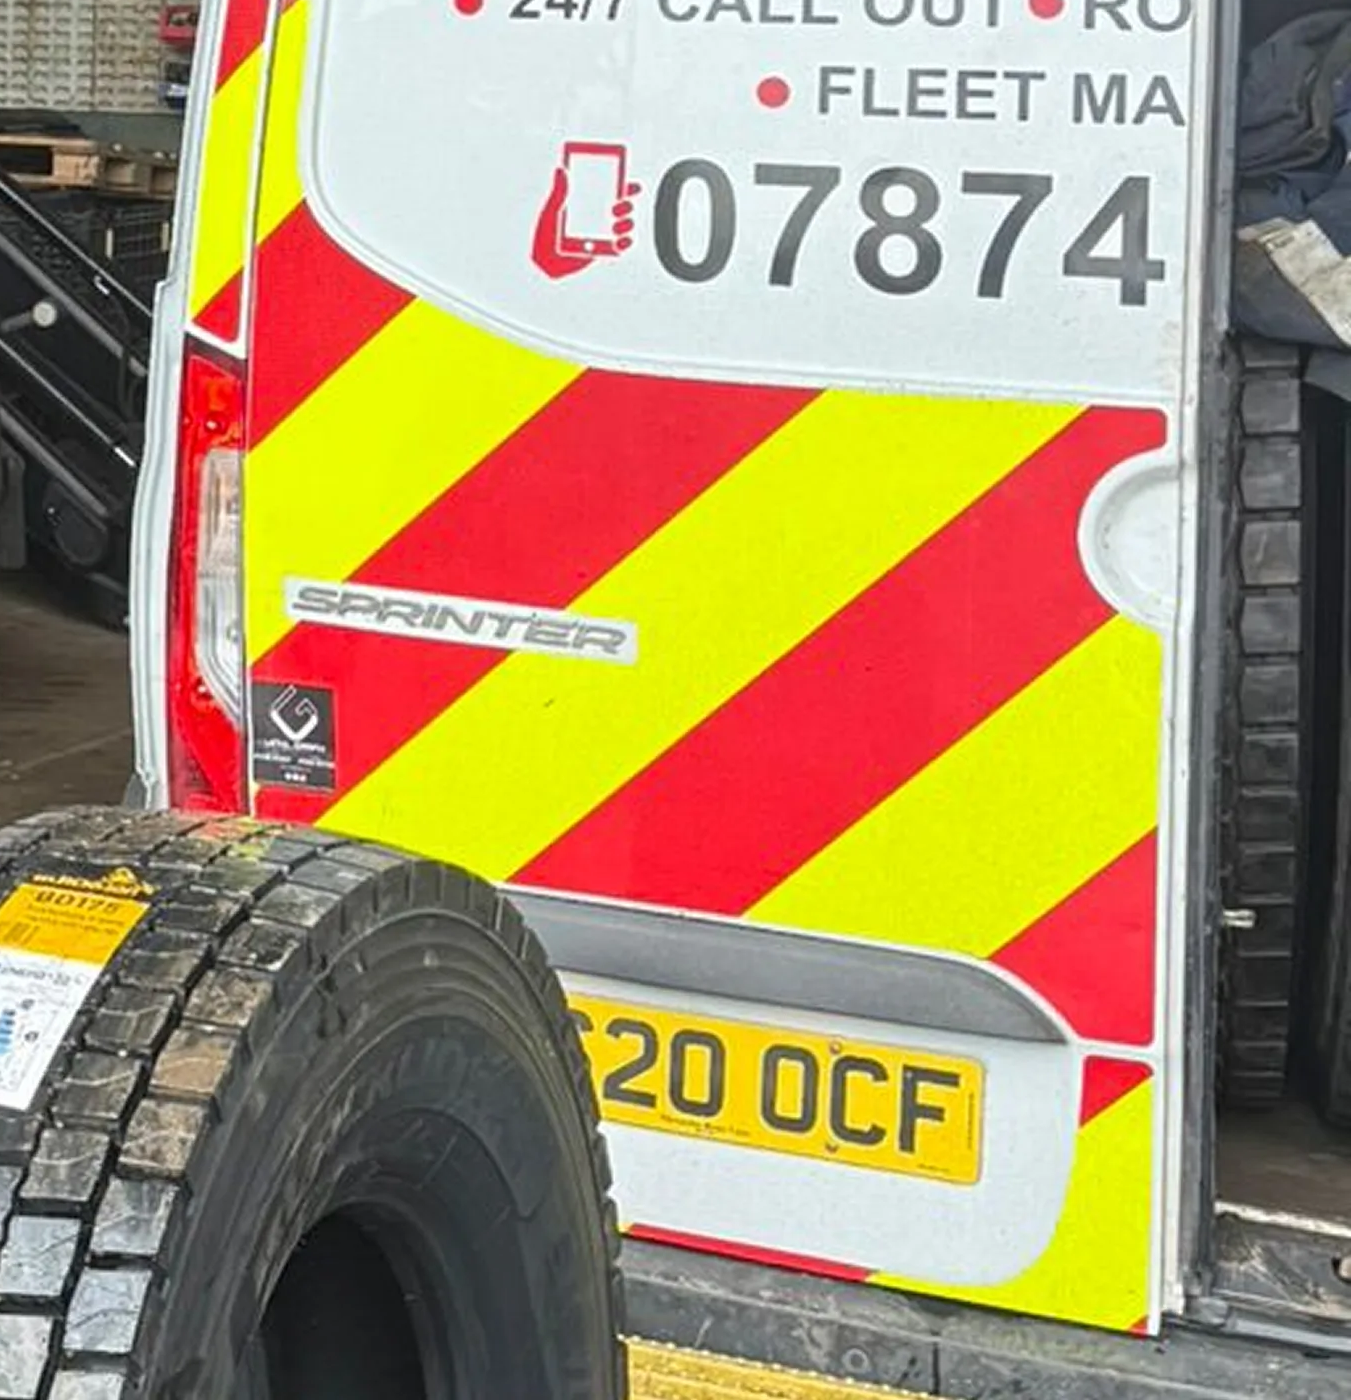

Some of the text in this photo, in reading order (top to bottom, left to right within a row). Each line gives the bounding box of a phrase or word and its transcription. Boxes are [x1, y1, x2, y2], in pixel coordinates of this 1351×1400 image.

[816, 65, 1186, 127] FLEET MA
[652, 158, 1166, 308] 07874
[290, 585, 628, 656] SPRINTER
[569, 1008, 726, 1118] 20
